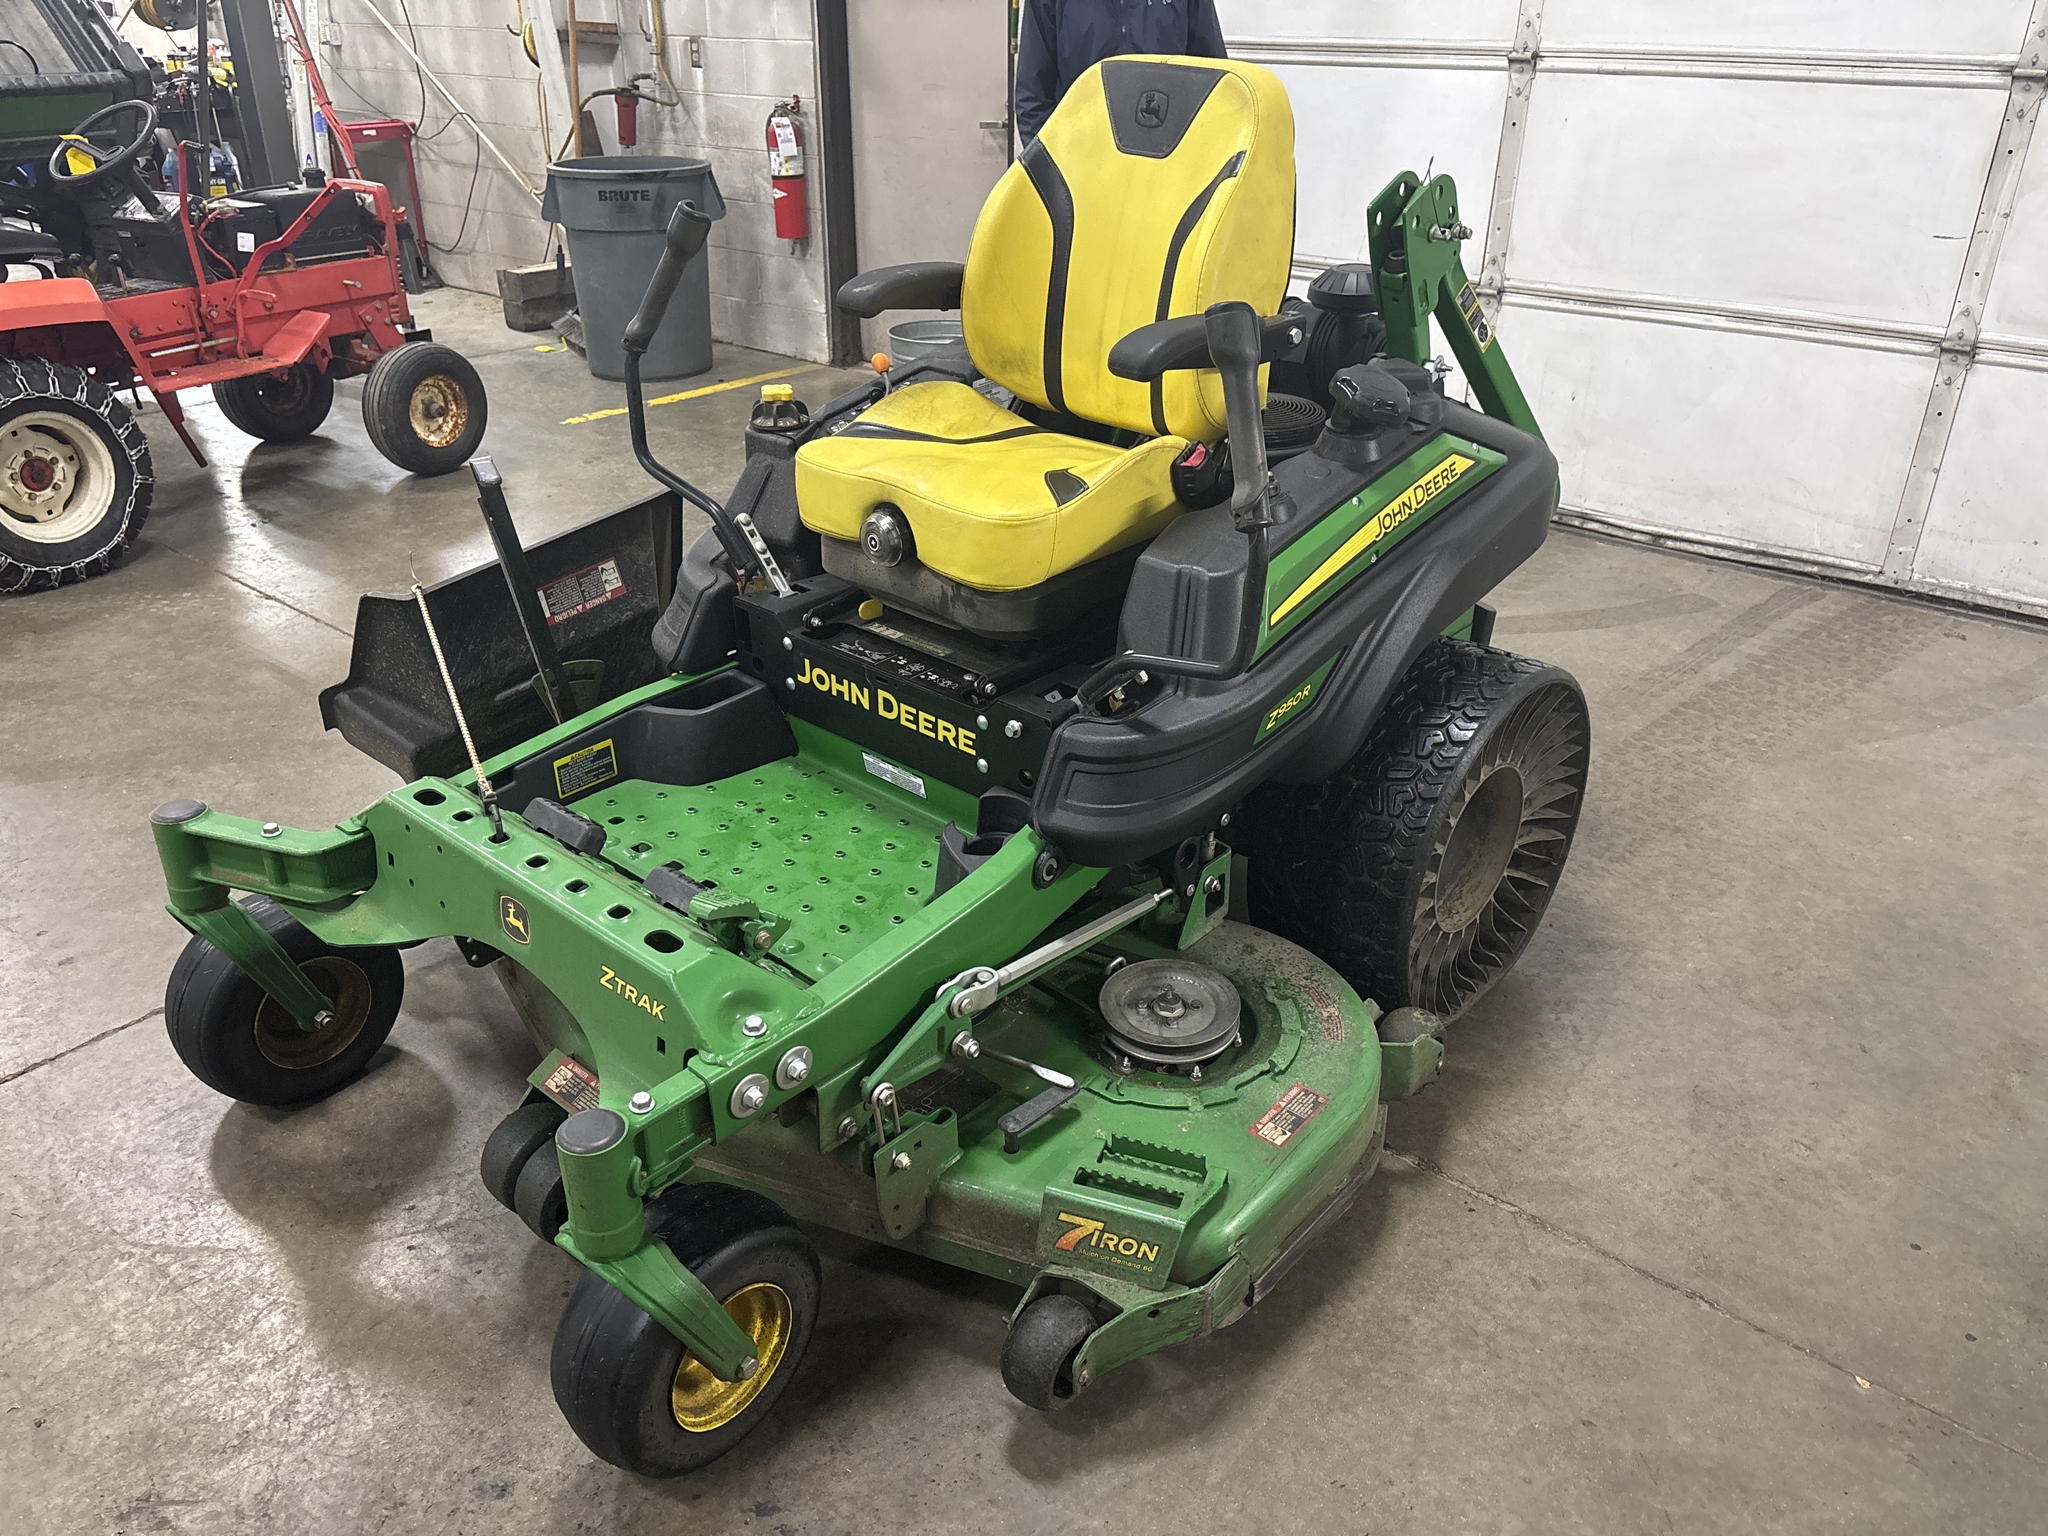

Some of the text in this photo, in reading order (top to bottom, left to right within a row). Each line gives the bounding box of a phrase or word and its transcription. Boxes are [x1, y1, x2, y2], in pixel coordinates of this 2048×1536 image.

[598, 190, 651, 202] BRUTE
[1375, 461, 1459, 539] JOHN DEERE
[554, 607, 578, 623] PELIGRO
[797, 658, 870, 710] JOHN
[877, 688, 977, 757] DEERE
[1265, 684, 1312, 731] Z950R
[600, 964, 667, 1022] ZTRAK
[1079, 1248, 1100, 1258] Mulch
[1100, 1253, 1110, 1261] on
[1111, 1256, 1142, 1270] Demand
